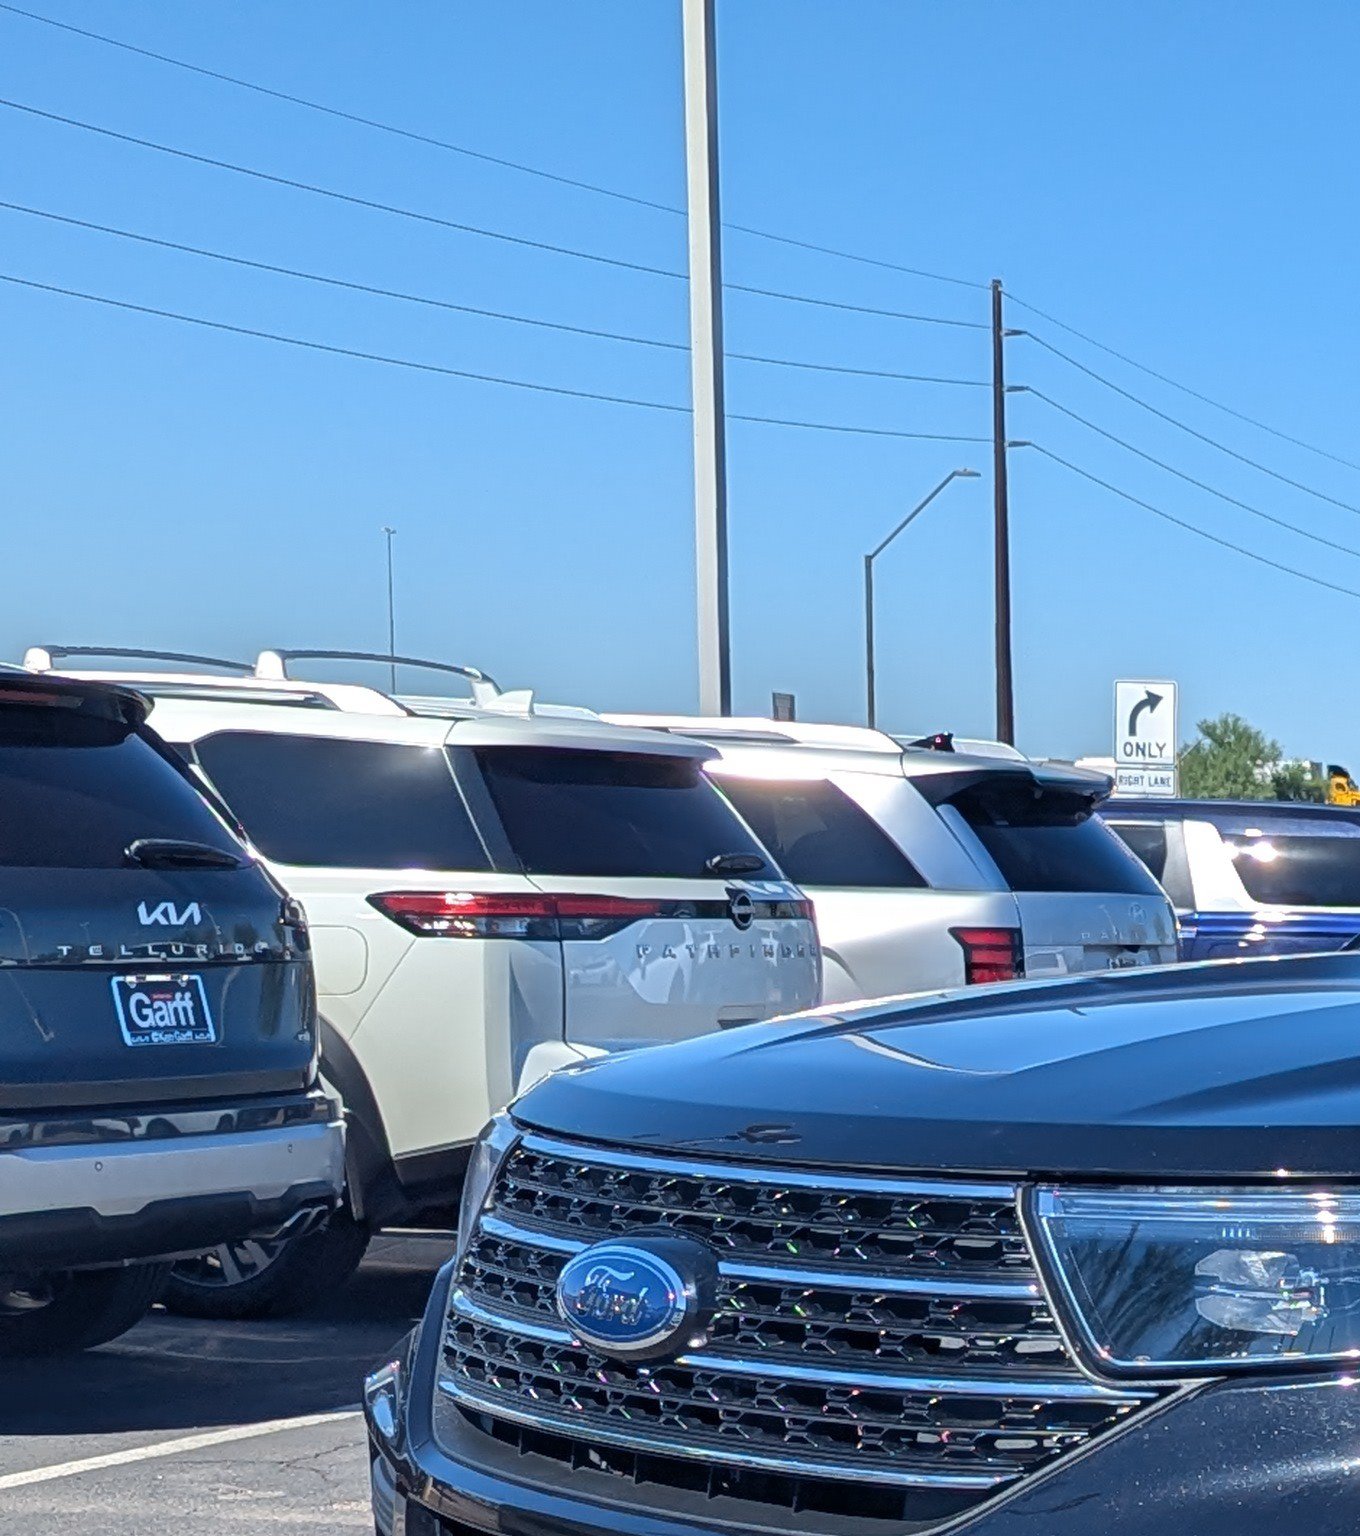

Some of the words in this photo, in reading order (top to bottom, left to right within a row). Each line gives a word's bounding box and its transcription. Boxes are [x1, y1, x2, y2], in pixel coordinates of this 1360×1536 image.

[1123, 741, 1166, 759] ONLY
[1118, 775, 1144, 787] RIGHT
[1148, 777, 1171, 788] LANE
[137, 901, 201, 925] KIA
[57, 942, 269, 956] TELLURIDE
[129, 992, 196, 1028] Garff
